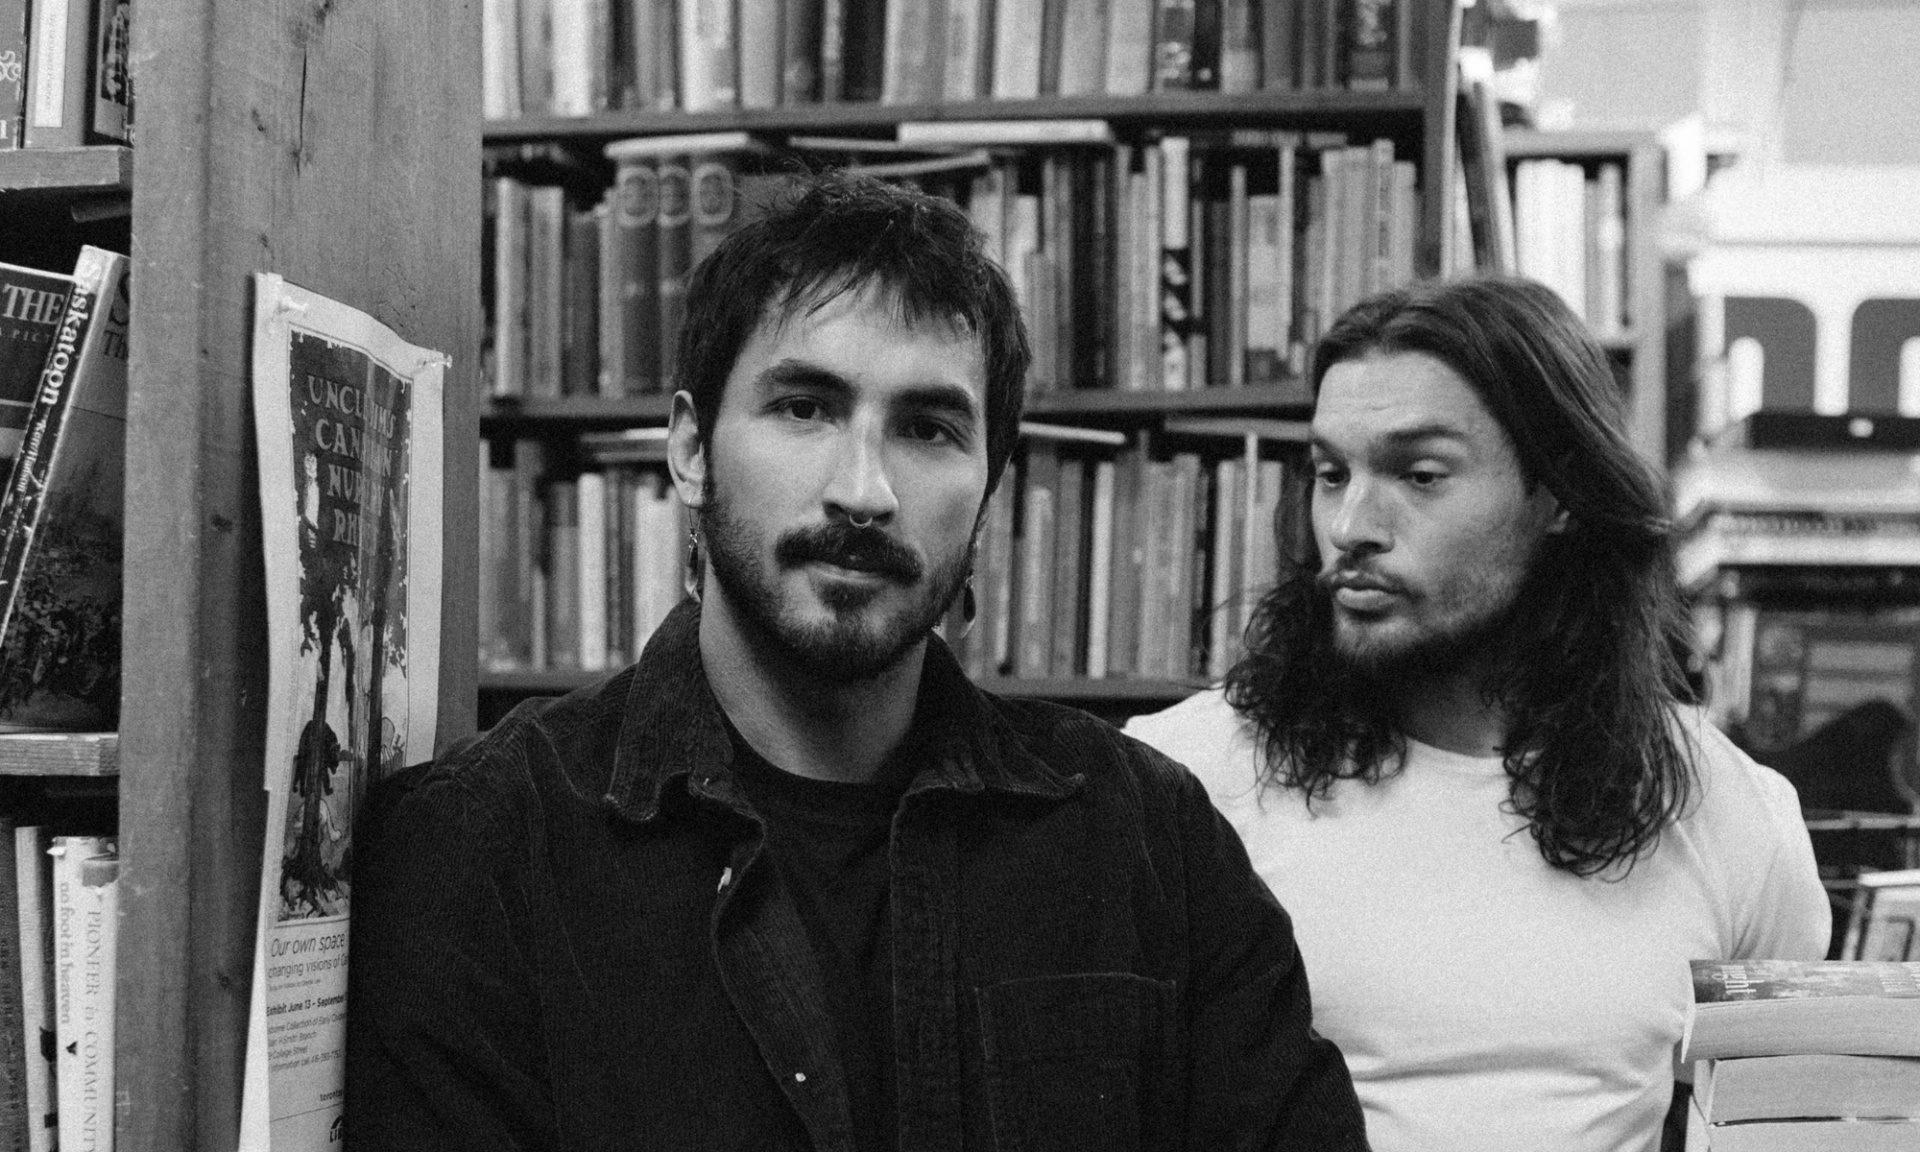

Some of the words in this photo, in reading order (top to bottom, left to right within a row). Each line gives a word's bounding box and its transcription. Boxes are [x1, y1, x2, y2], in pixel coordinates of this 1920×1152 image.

[3, 284, 65, 325] THE
[60, 882, 70, 902] no
[60, 905, 75, 938] foot
[60, 941, 74, 958] in
[85, 911, 101, 996] PIONEER
[271, 938, 290, 957] Our
[292, 937, 316, 954] own
[318, 933, 345, 954] space
[268, 962, 303, 978] changing
[306, 958, 331, 972] visions
[60, 961, 75, 1025] heaven
[85, 1004, 99, 1021] in
[266, 1002, 287, 1017] Exhibit
[287, 1002, 303, 1013] June
[304, 999, 311, 1010] 13
